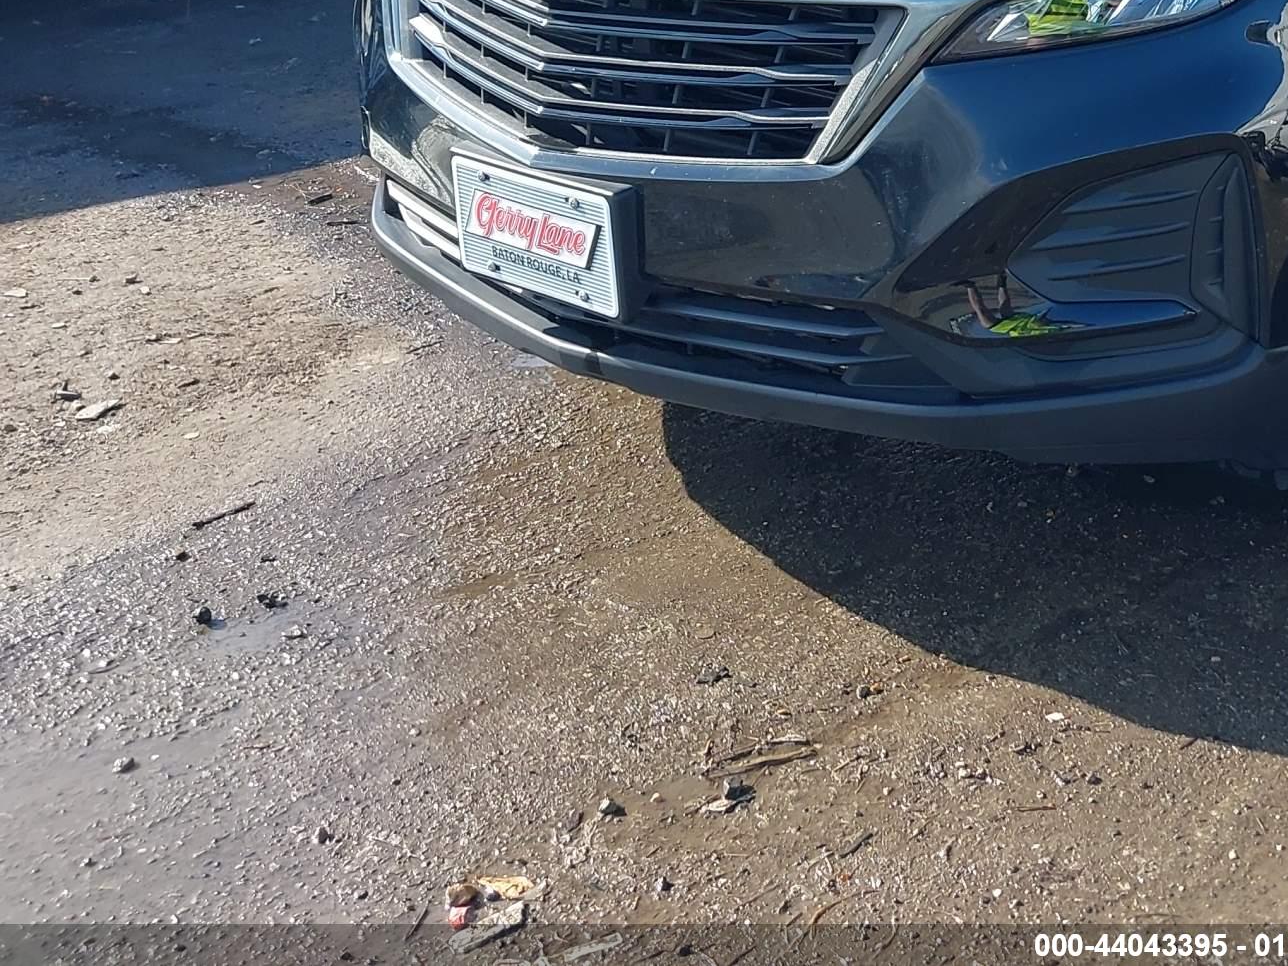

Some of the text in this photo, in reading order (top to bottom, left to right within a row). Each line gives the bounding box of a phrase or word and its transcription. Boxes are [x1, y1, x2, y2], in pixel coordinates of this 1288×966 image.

[476, 191, 586, 255] Gerry Lane
[491, 245, 524, 266] BATON
[566, 269, 582, 284] LA
